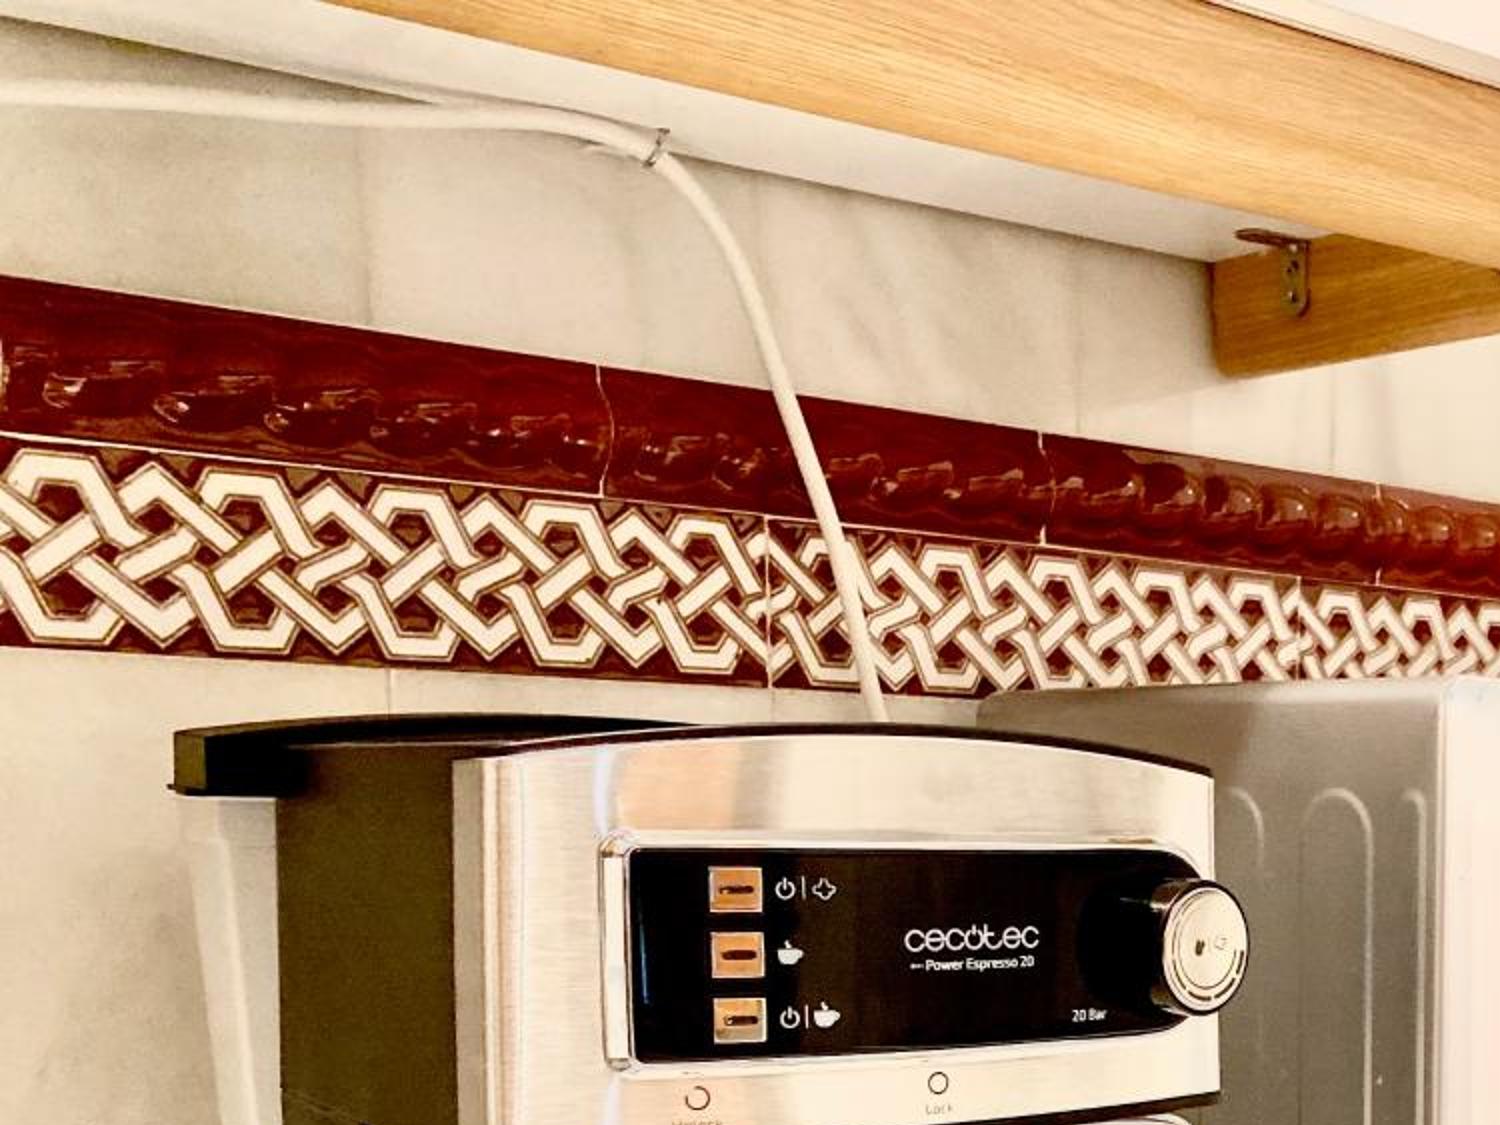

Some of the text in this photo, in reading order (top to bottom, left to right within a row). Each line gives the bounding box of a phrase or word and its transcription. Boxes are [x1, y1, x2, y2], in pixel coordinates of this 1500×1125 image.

[904, 923, 1040, 953] cecotec
[925, 958, 965, 973] Power
[965, 956, 1019, 973] Espresso
[1019, 955, 1035, 968] 20
[1071, 1007, 1108, 1022] 20 Bar
